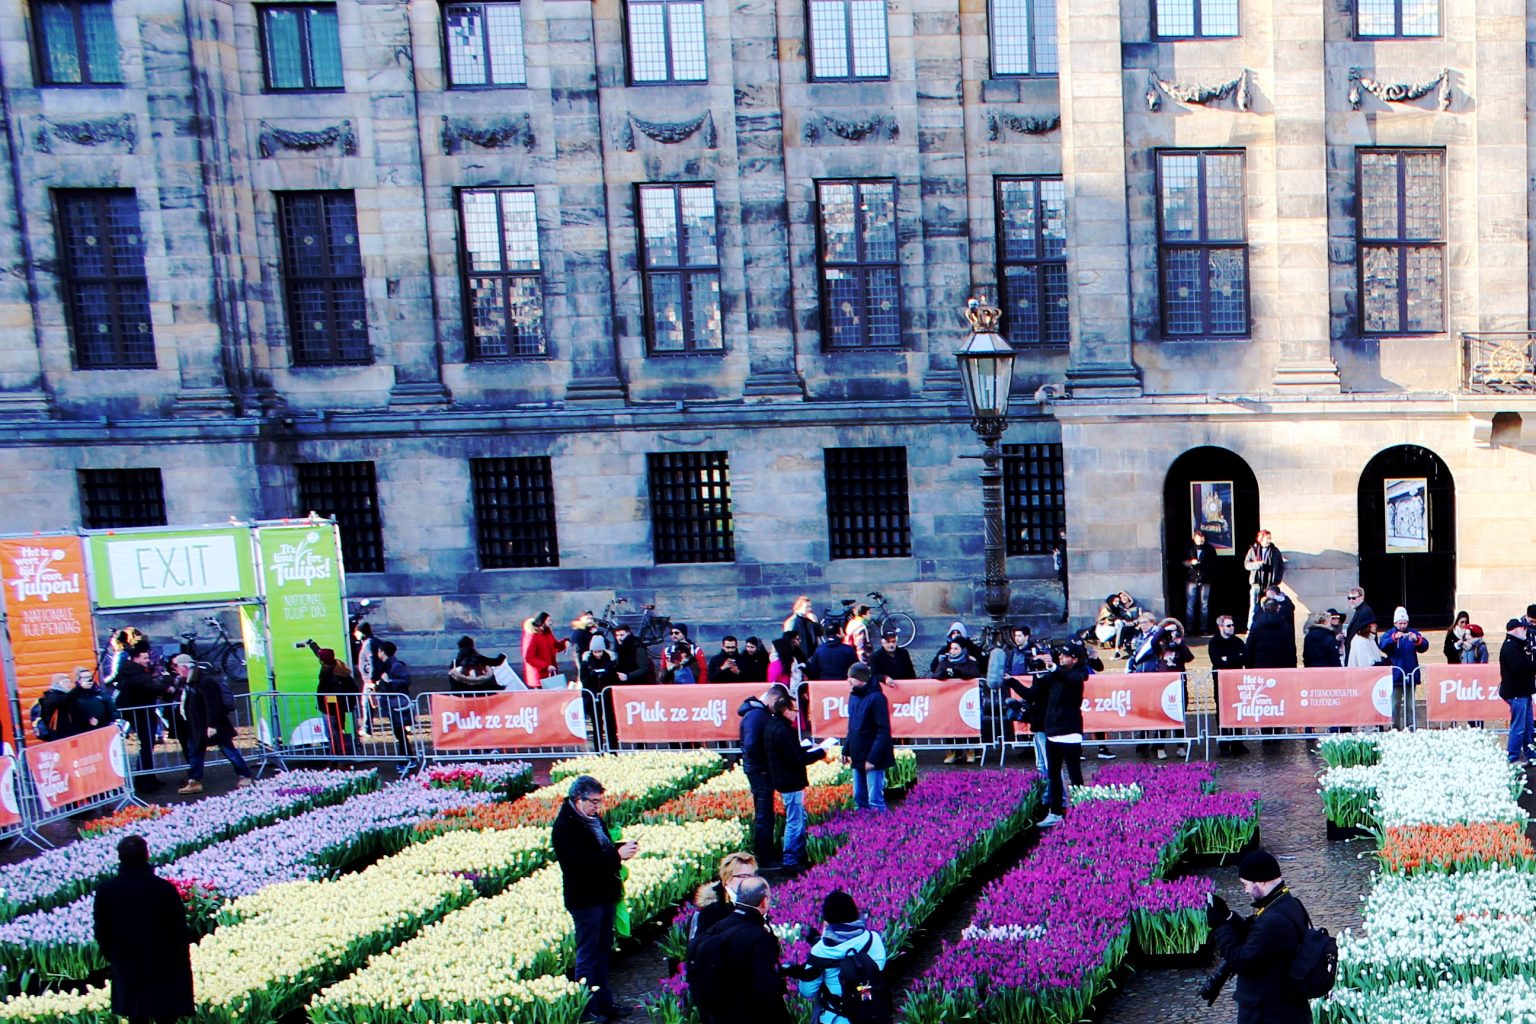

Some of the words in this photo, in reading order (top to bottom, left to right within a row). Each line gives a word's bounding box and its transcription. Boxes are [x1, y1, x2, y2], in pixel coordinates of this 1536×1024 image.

[15, 557, 39, 565] weer
[21, 546, 38, 557] Het
[40, 547, 50, 557] is
[273, 552, 294, 562] time
[306, 551, 322, 565] for
[42, 573, 63, 581] voor
[136, 545, 210, 589] EXIT
[270, 557, 331, 586] Tulips!
[10, 573, 80, 602] Tulpen!
[23, 608, 76, 622] NATIONALE
[22, 620, 81, 637] TULPENDAG
[1243, 675, 1257, 684] Het
[1257, 676, 1264, 684] is
[1439, 679, 1485, 703] Pluk
[1488, 686, 1501, 700] z
[1094, 690, 1132, 717] zelf!
[1239, 690, 1251, 703] tijd
[441, 711, 483, 733] Pluk
[485, 714, 502, 729] ze
[504, 706, 538, 734] zelf!
[625, 701, 667, 725] Pluk
[670, 707, 688, 722] ze
[692, 699, 727, 727] zelf!
[892, 695, 930, 723] zelf!
[1232, 699, 1285, 722] Tulpen!
